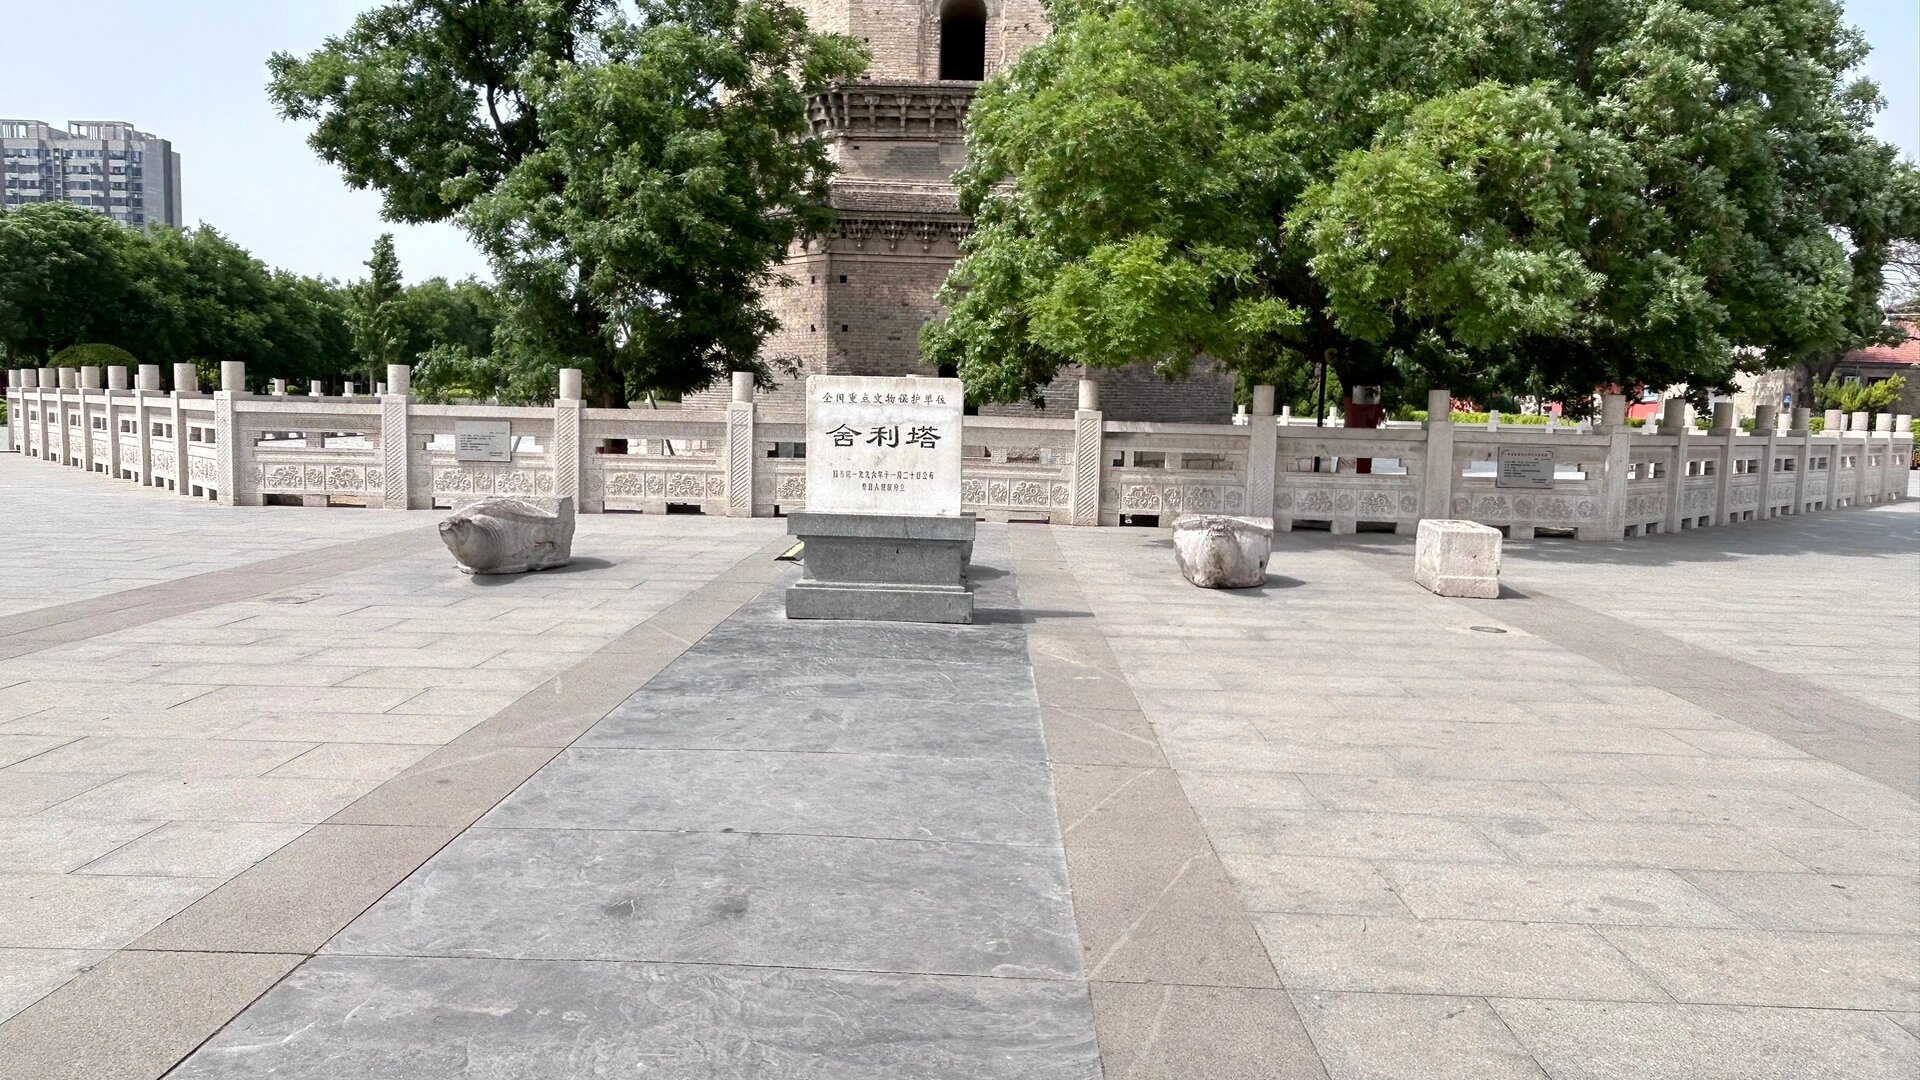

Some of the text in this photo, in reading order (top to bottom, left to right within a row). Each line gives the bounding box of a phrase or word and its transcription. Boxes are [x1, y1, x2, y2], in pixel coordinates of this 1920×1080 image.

[822, 391, 947, 405] 全国重点文物保护单位
[825, 423, 942, 450] 舍利塔
